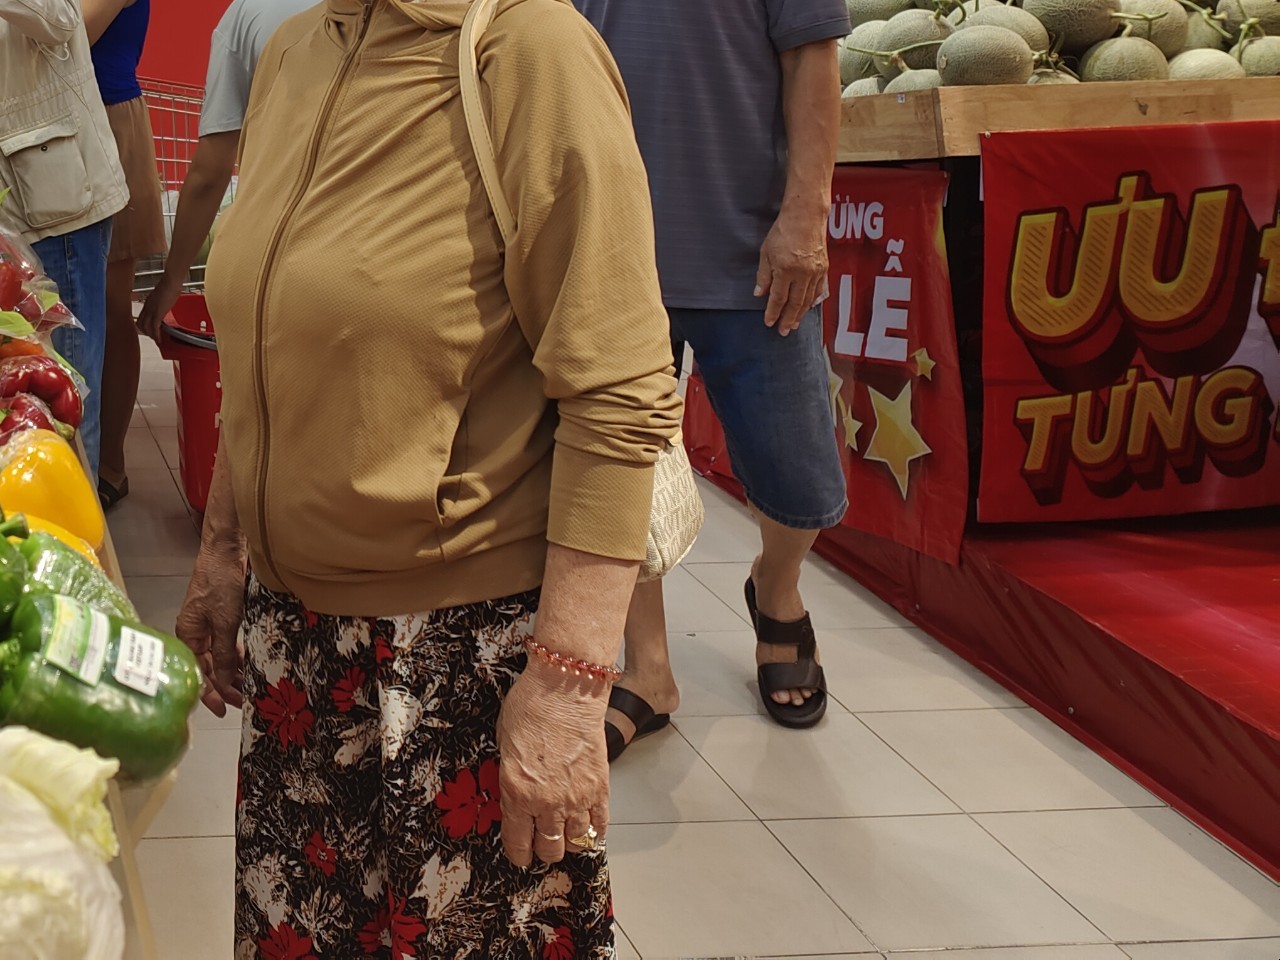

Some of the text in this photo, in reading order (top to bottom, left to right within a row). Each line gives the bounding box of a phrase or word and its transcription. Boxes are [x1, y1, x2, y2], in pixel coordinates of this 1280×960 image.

[827, 193, 884, 239] ỪNG
[1010, 175, 1230, 338] ƯU
[834, 239, 912, 362] LỄ
[1017, 368, 1254, 471] TƯNG
